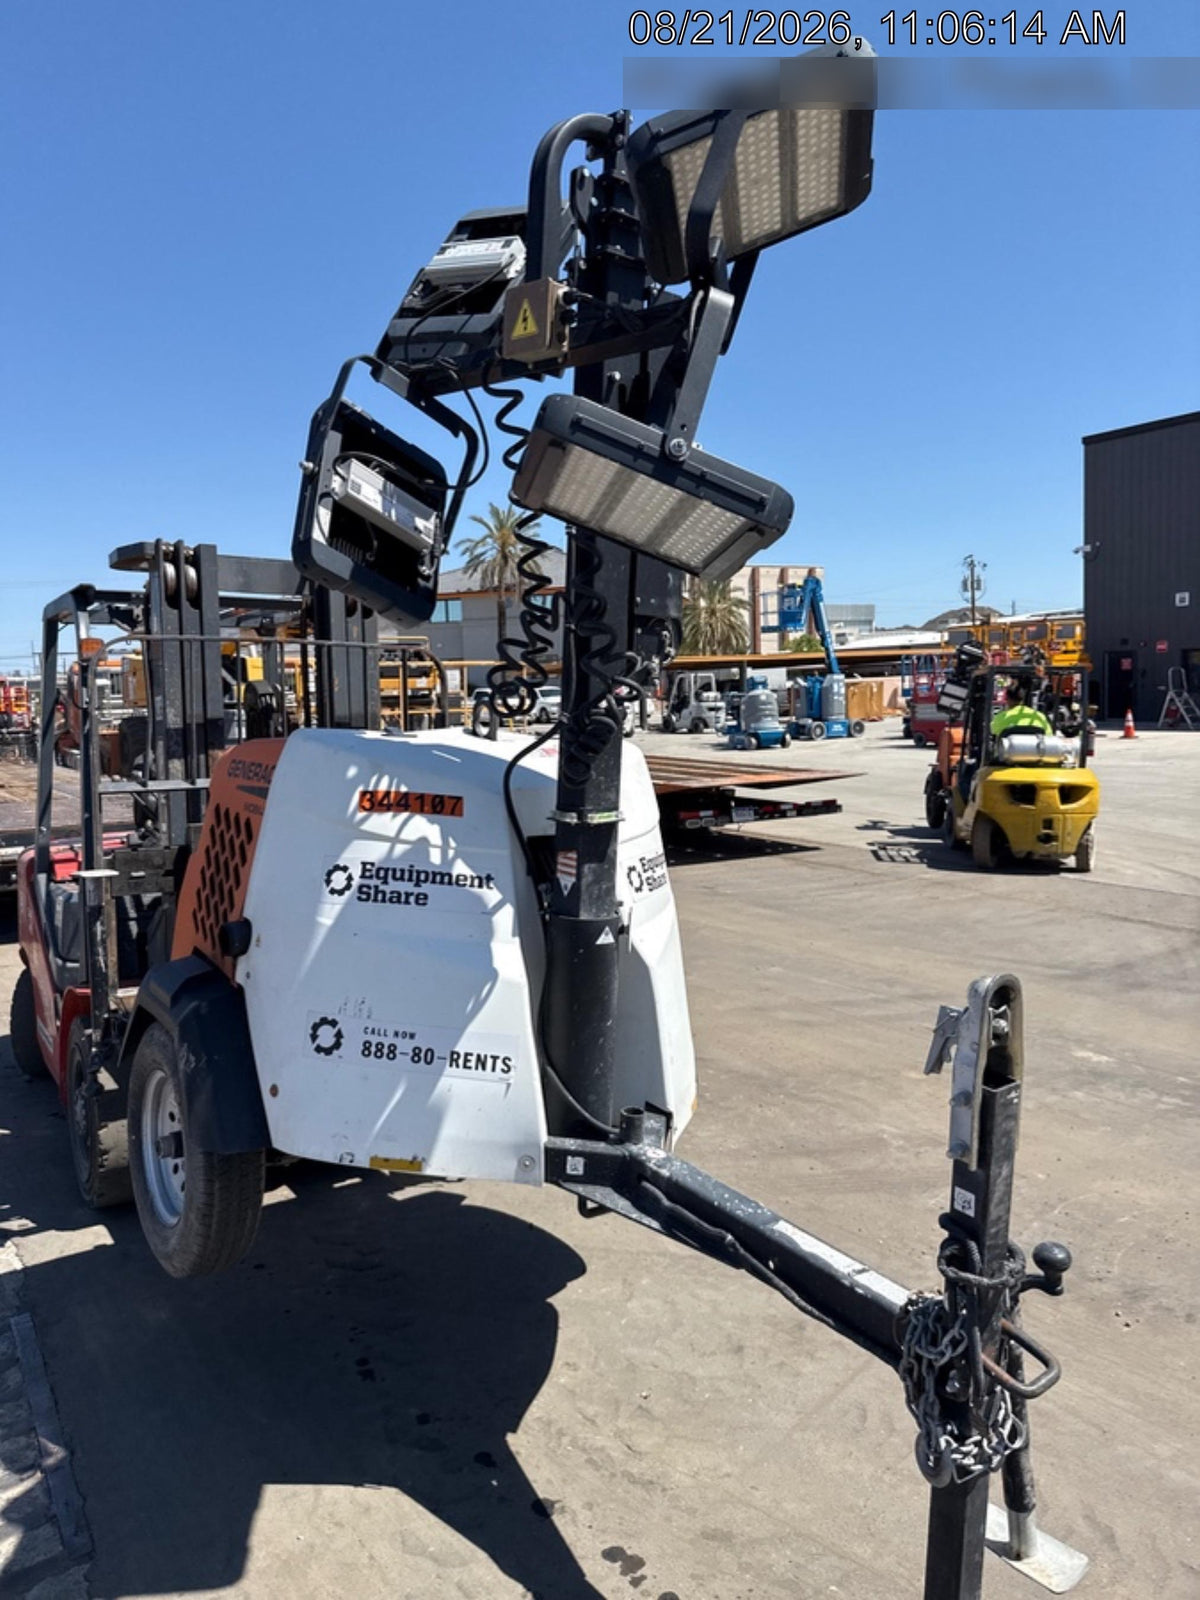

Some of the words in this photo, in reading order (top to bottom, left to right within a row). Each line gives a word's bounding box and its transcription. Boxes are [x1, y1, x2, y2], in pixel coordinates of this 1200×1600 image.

[361, 790, 462, 816] 344107
[360, 861, 495, 891] Equipment
[357, 884, 430, 907] Share
[363, 1026, 388, 1038] CALL
[393, 1030, 417, 1041] NOW
[361, 1040, 512, 1074] 888-80-RENTS
